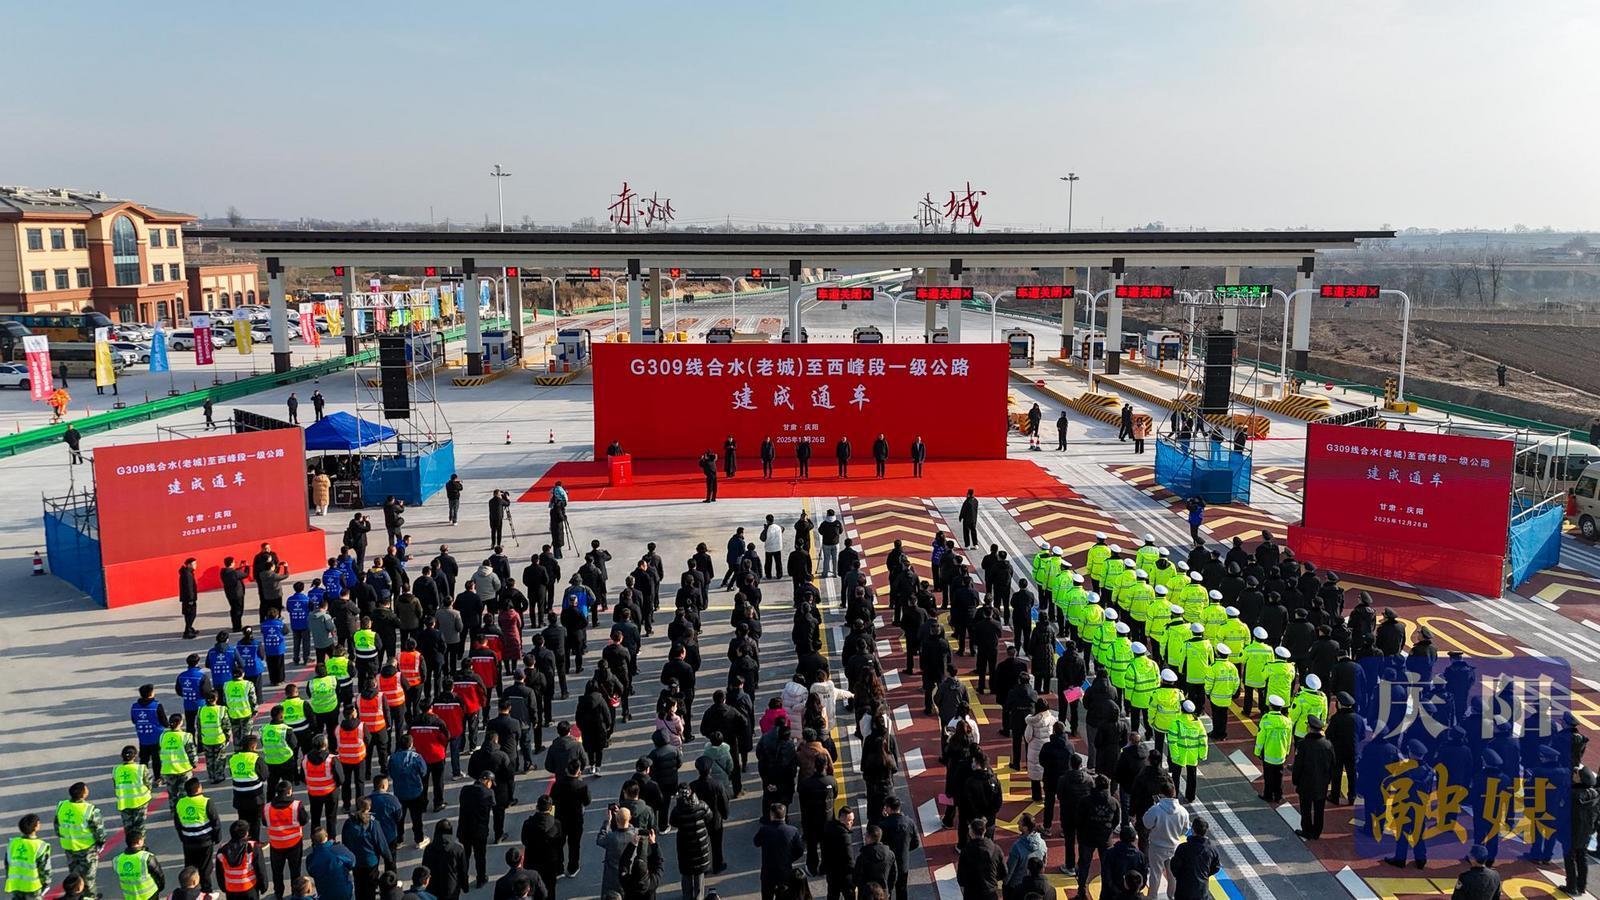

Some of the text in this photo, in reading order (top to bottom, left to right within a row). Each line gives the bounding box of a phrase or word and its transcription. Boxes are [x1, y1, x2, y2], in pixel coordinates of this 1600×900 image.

[607, 181, 987, 228] 赤 城
[630, 358, 970, 378] G309线合水(老城)至西峰段一级公路
[732, 384, 871, 411] 建成通车
[776, 436, 825, 444] 2025年1月26日
[116, 448, 284, 475] G309线合水(老城)至西峰段一级公路
[1326, 443, 1491, 469] G309线合水(老城)至西峰段一级公路
[167, 471, 246, 495] 建成通车
[1366, 465, 1444, 488] 建成通车
[182, 523, 238, 537] 2025年12月26日
[1373, 516, 1429, 529] 2025年12月26日
